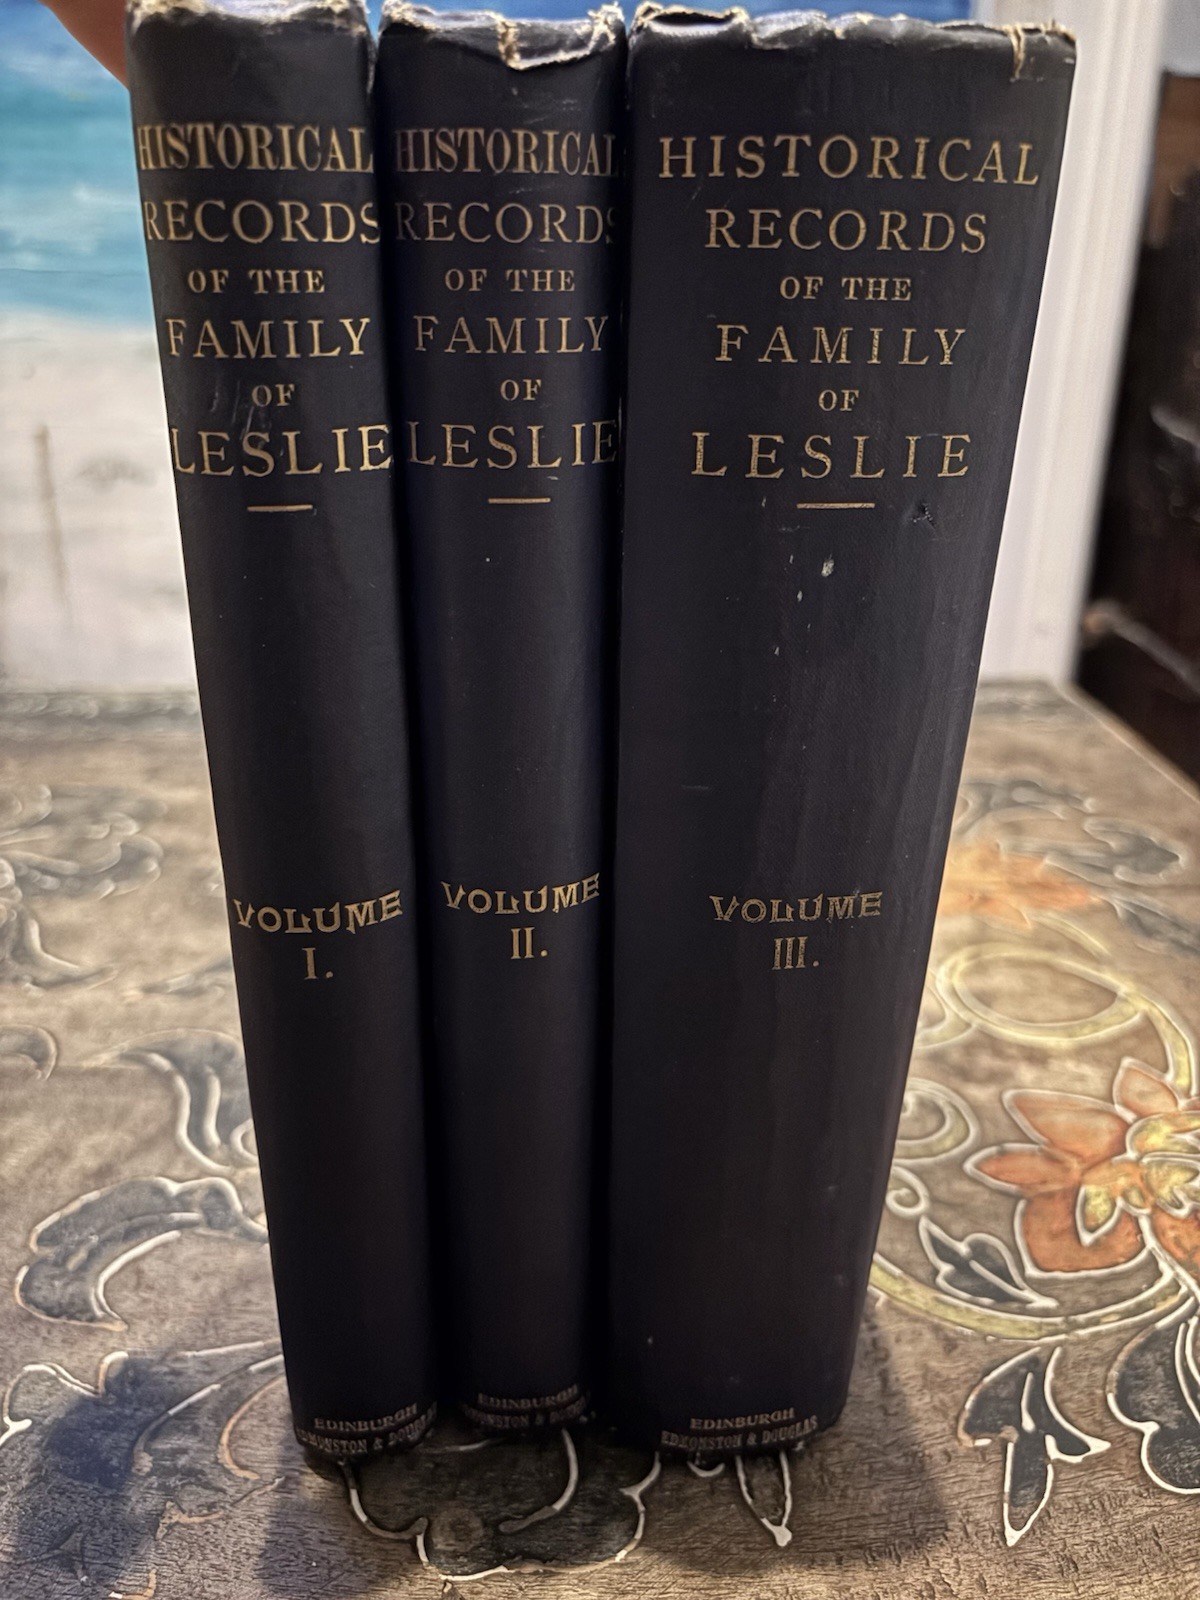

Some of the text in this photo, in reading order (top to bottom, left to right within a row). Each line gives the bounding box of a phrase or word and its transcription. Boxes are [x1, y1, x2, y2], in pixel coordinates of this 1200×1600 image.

[137, 122, 375, 173] HISTORICAL
[395, 127, 618, 178] HISTORICAL
[658, 134, 1039, 185] HISTORICAL
[144, 201, 381, 244] RECORDS
[704, 208, 987, 254] RECORDS
[187, 268, 326, 294] OF THE
[445, 268, 576, 292] OF THE
[779, 276, 912, 301] OF THE
[165, 317, 371, 359] FAMILY
[413, 315, 609, 354] FAMILY
[715, 324, 966, 366] FAMILY
[251, 383, 296, 408] OF
[500, 379, 542, 401] OF
[818, 389, 860, 412] OF
[169, 423, 393, 477] LESLIE
[407, 419, 617, 469] LESLIE
[691, 431, 971, 480] LESLIE
[440, 872, 600, 915] VOLUME
[709, 891, 883, 924] VOLUME
[233, 889, 403, 935] VOLUME
[510, 926, 548, 960] II.
[771, 936, 820, 970] III.
[301, 947, 334, 980] I.
[314, 1402, 418, 1432] EDINBURGH
[689, 1407, 795, 1430] EDINBURGH
[747, 1434, 757, 1446] &
